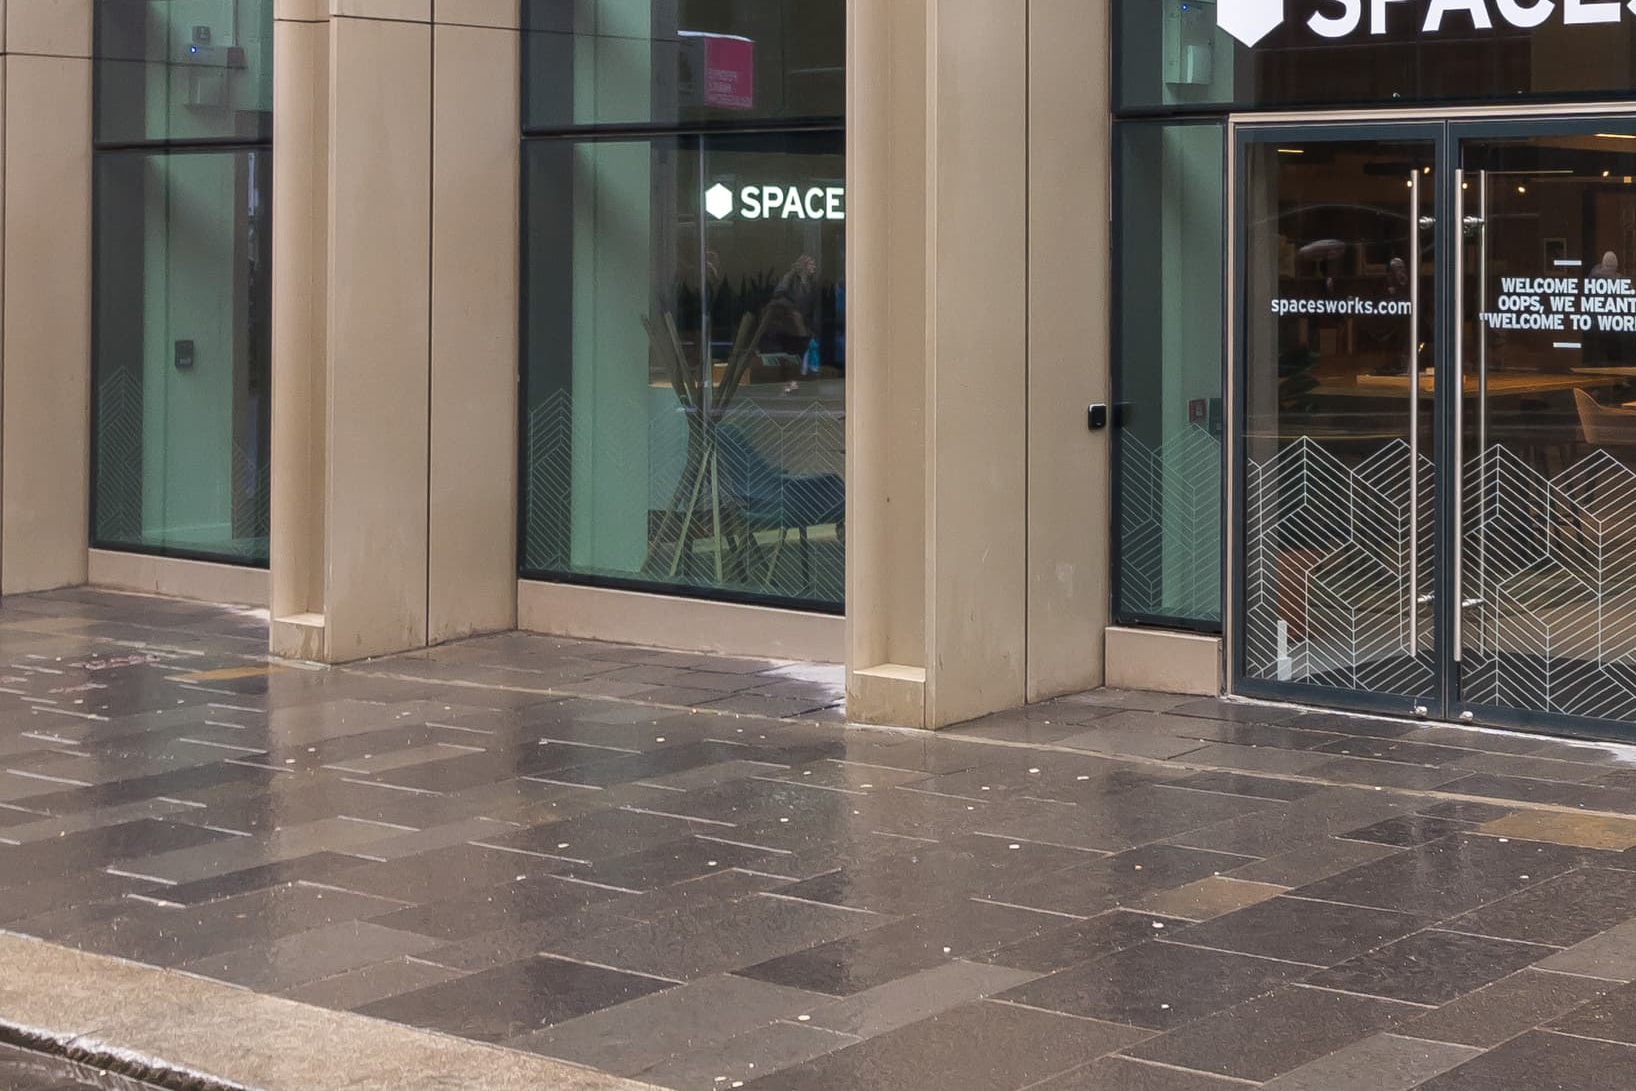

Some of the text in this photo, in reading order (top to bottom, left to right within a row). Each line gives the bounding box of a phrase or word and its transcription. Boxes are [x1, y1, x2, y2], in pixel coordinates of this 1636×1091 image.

[1501, 277, 1636, 295] WELCOME HOME.
[1271, 296, 1412, 315] spacesworks.com
[1498, 295, 1544, 313] OOPS,
[1550, 296, 1575, 312] WE
[1479, 312, 1565, 330] "WELCOME
[1570, 314, 1592, 331] TO
